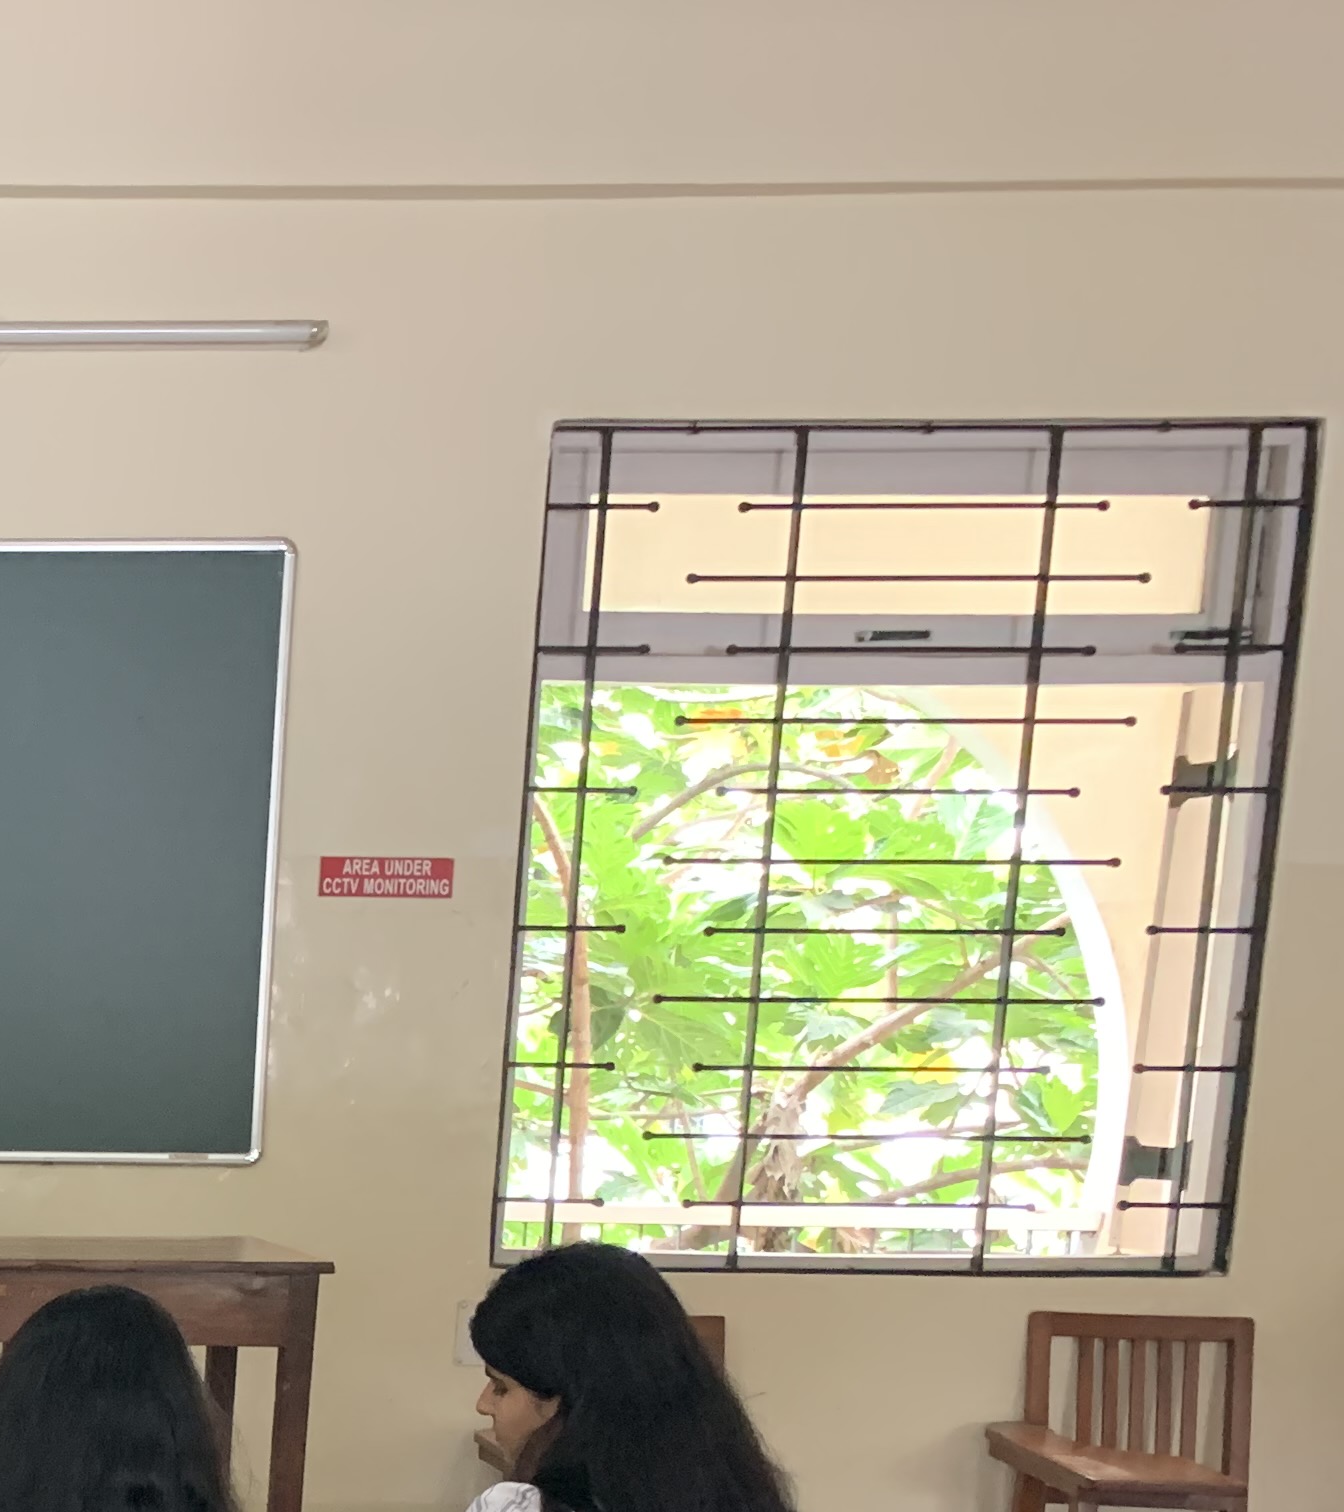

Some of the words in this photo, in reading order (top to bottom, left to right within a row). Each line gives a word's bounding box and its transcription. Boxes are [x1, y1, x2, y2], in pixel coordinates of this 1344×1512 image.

[342, 859, 380, 875] AREA
[385, 860, 432, 876] UNDER
[323, 878, 359, 894] CCTV
[363, 879, 449, 895] MONITORING
